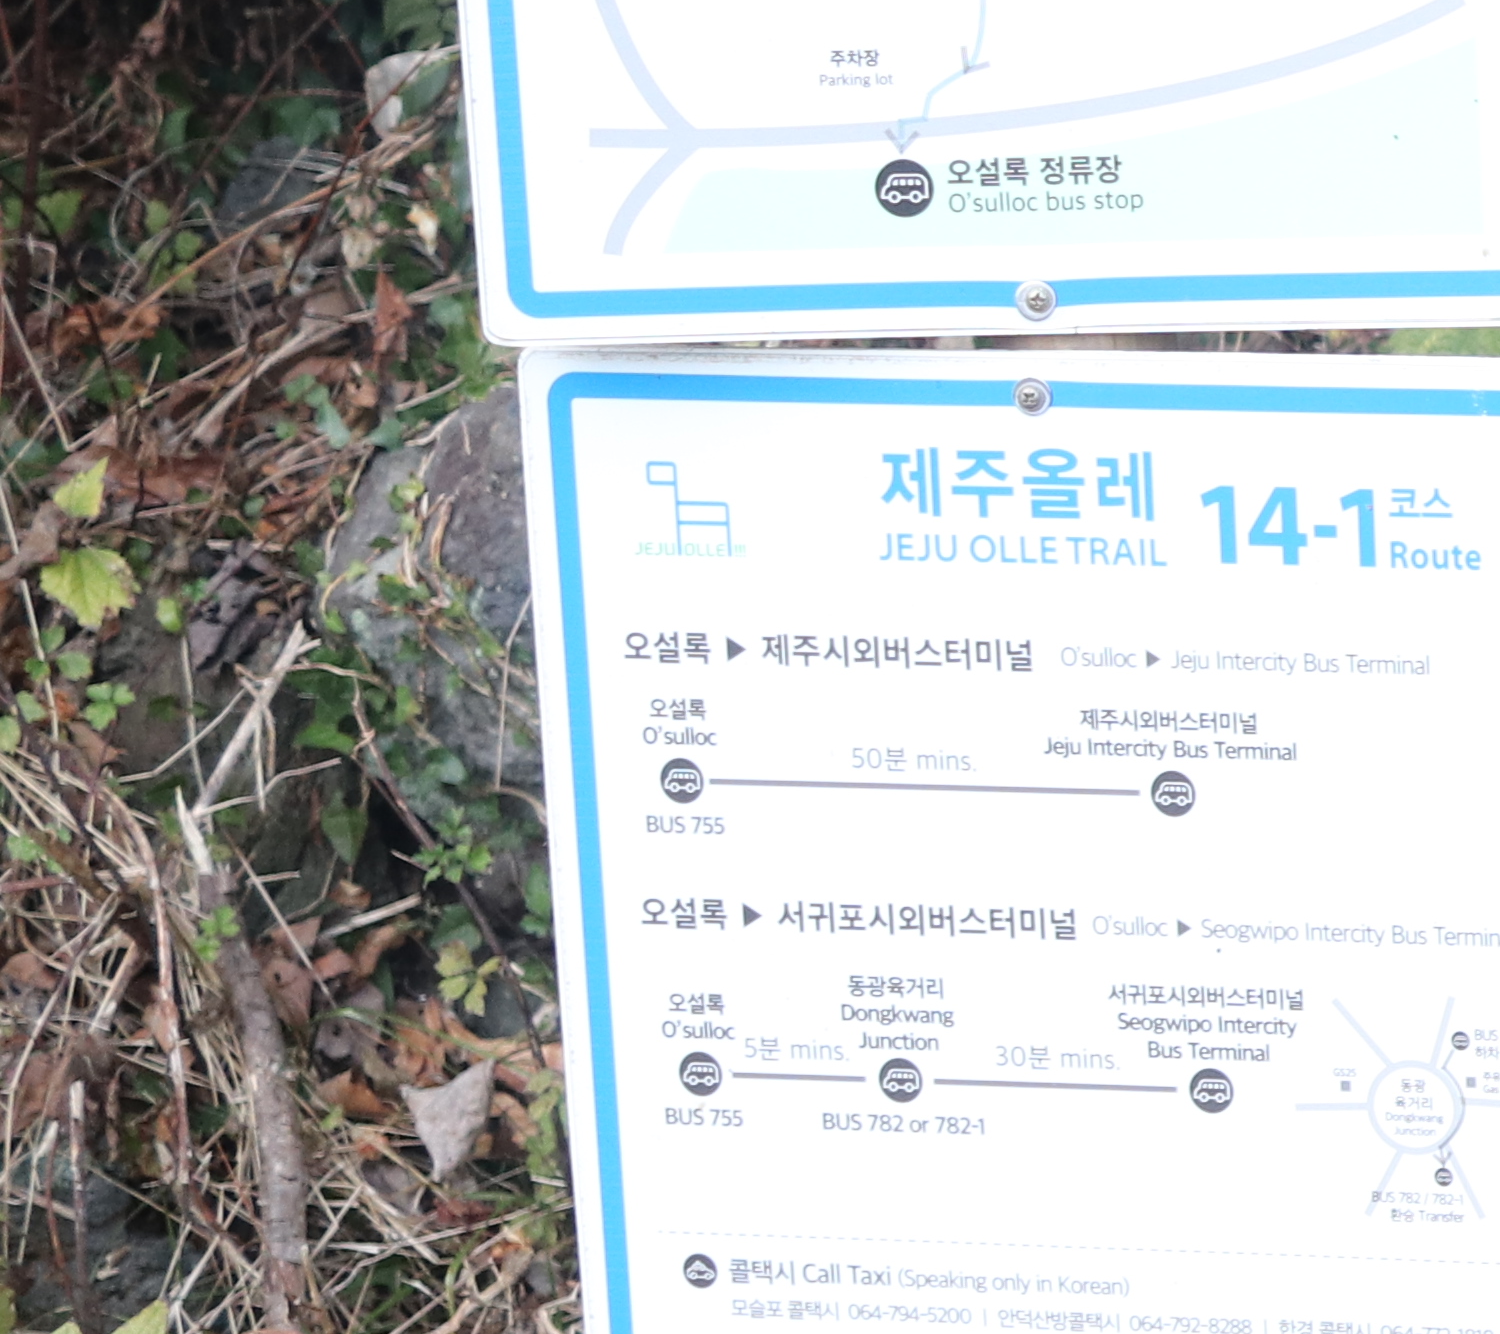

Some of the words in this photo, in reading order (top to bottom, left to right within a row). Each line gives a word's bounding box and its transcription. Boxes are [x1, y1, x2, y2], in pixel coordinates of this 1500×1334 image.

[948, 158, 1029, 186] 오설록
[1040, 155, 1122, 185] 정류장
[1046, 191, 1086, 211] bus
[1094, 192, 1144, 212] stop
[882, 447, 1154, 521] 제주올레
[1389, 488, 1453, 518] 코스
[1201, 486, 1376, 567] 14-1
[880, 533, 957, 562] JEJU
[970, 535, 1058, 564] OLLE
[1066, 537, 1167, 566] TRAIL
[1390, 541, 1481, 570] Route
[625, 632, 711, 664] 오설록
[762, 634, 1032, 672] 제주시외버스터미널
[1171, 651, 1209, 673] Jeju
[1217, 651, 1297, 675] Intercity
[1304, 653, 1339, 673] Bus
[1345, 654, 1430, 675] Terminal
[650, 699, 706, 720] 오설록
[1080, 709, 1257, 734] 제주시외버스터미널
[852, 747, 907, 772] 50분
[917, 750, 976, 771] mins.
[1044, 737, 1081, 758] Jeju
[1088, 738, 1167, 760] Intercity
[1214, 741, 1296, 760] Terminal
[646, 815, 686, 834] BUS
[642, 898, 727, 930] 오설록
[778, 901, 1076, 940] 서귀포시외버스터미널
[1201, 919, 1299, 943] Seogwipo
[1305, 923, 1385, 947] Intercity
[1392, 925, 1427, 945] Bus
[848, 975, 943, 999] 동광육거리
[1109, 984, 1303, 1010] 서귀포시외버스터미널
[669, 993, 724, 1014] 오설록
[841, 1004, 954, 1027] Dongkwang
[1118, 1013, 1212, 1034] Seogwipo
[1218, 1015, 1298, 1037] Intercity
[745, 1037, 780, 1061] 5분
[790, 1040, 849, 1061] mins.
[996, 1046, 1050, 1070] 30분
[1061, 1049, 1120, 1070] mins.
[1188, 1042, 1269, 1061] Terminal
[665, 1107, 704, 1126] BUS
[729, 1259, 795, 1285] 콜택시
[802, 1263, 840, 1283] Call
[847, 1265, 891, 1285] Taxi
[898, 1268, 988, 1293] (Speaking
[992, 1273, 1030, 1295] only
[1058, 1276, 1129, 1297] Korean)
[732, 1299, 783, 1318] 모슬포
[787, 1301, 839, 1320] 콜택시
[848, 1304, 972, 1324] 064-794-5200
[998, 1309, 1120, 1332] 안덕산방콜택시
[1129, 1315, 1252, 1334] 064-792-8288
